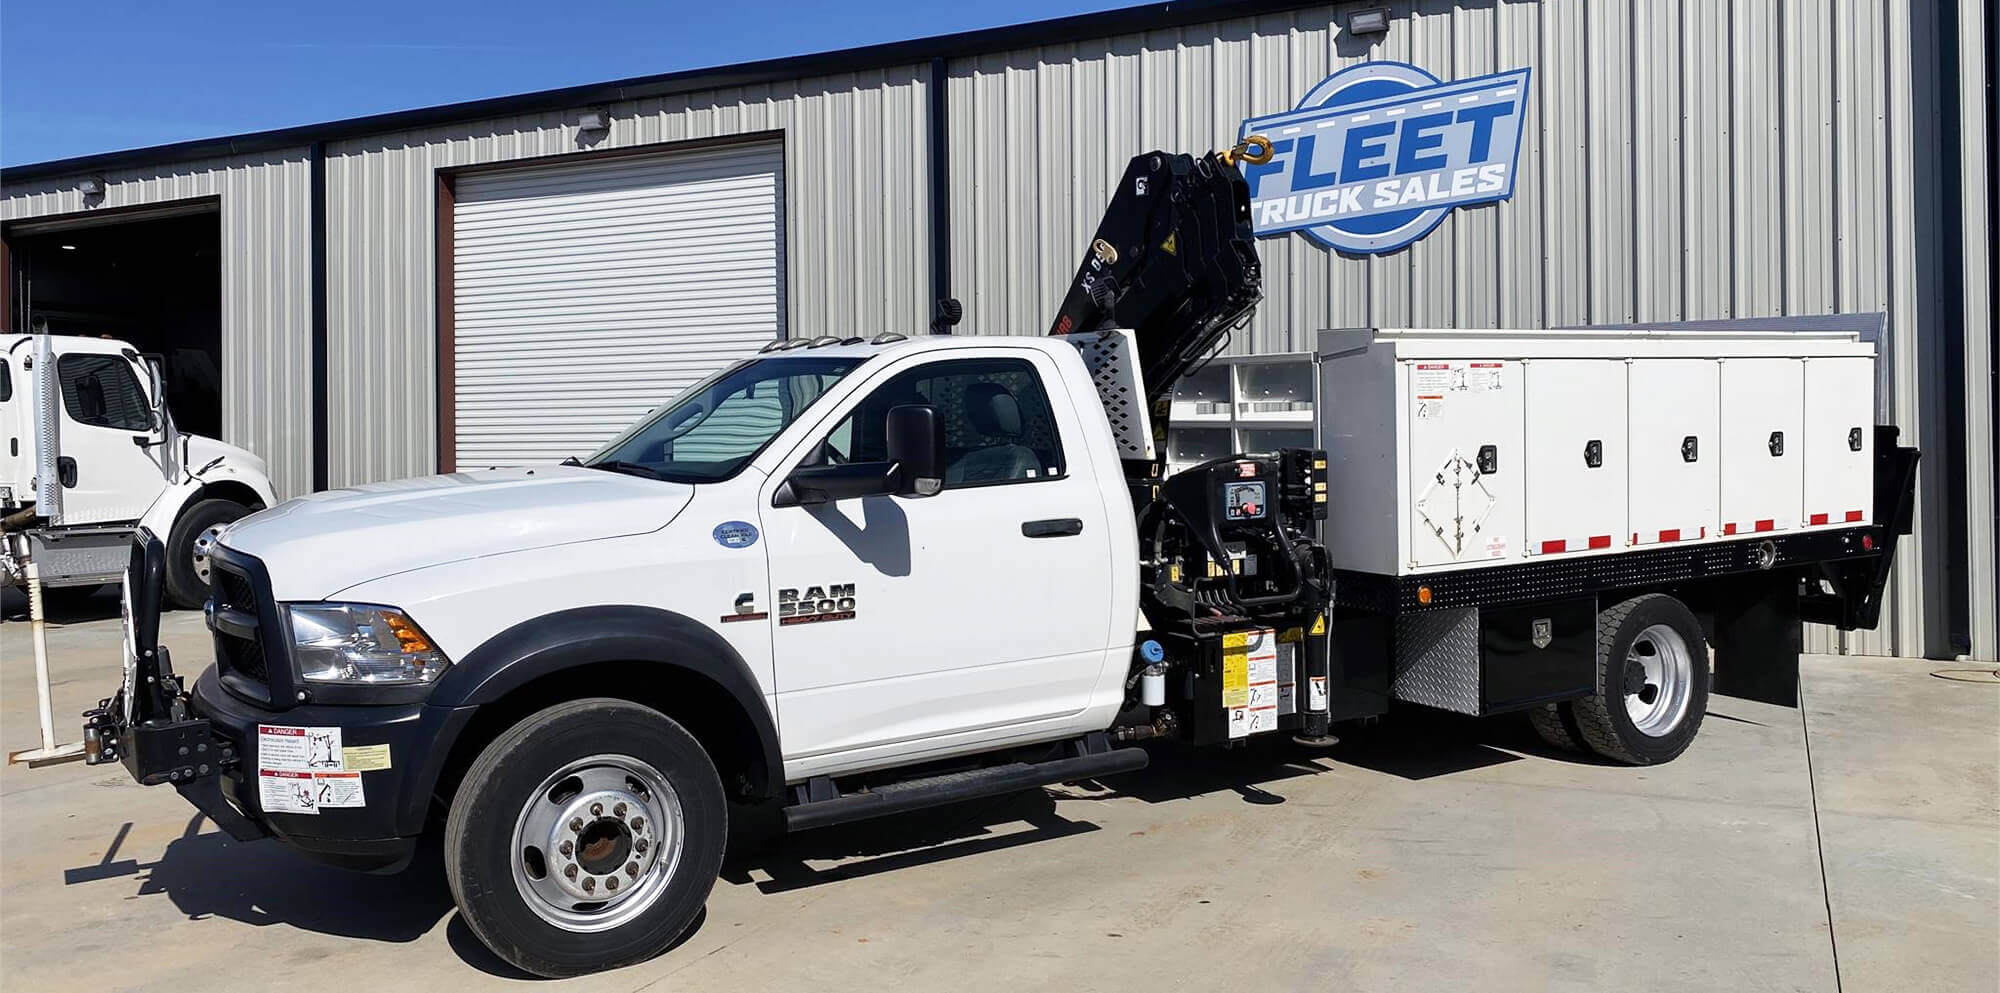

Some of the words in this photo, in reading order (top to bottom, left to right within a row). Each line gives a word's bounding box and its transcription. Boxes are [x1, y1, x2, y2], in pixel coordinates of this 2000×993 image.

[1245, 100, 1515, 199] FLEET
[1372, 163, 1506, 208] SALES
[778, 583, 856, 603] RAM
[779, 598, 856, 617] 5500
[273, 727, 298, 736] DANGER
